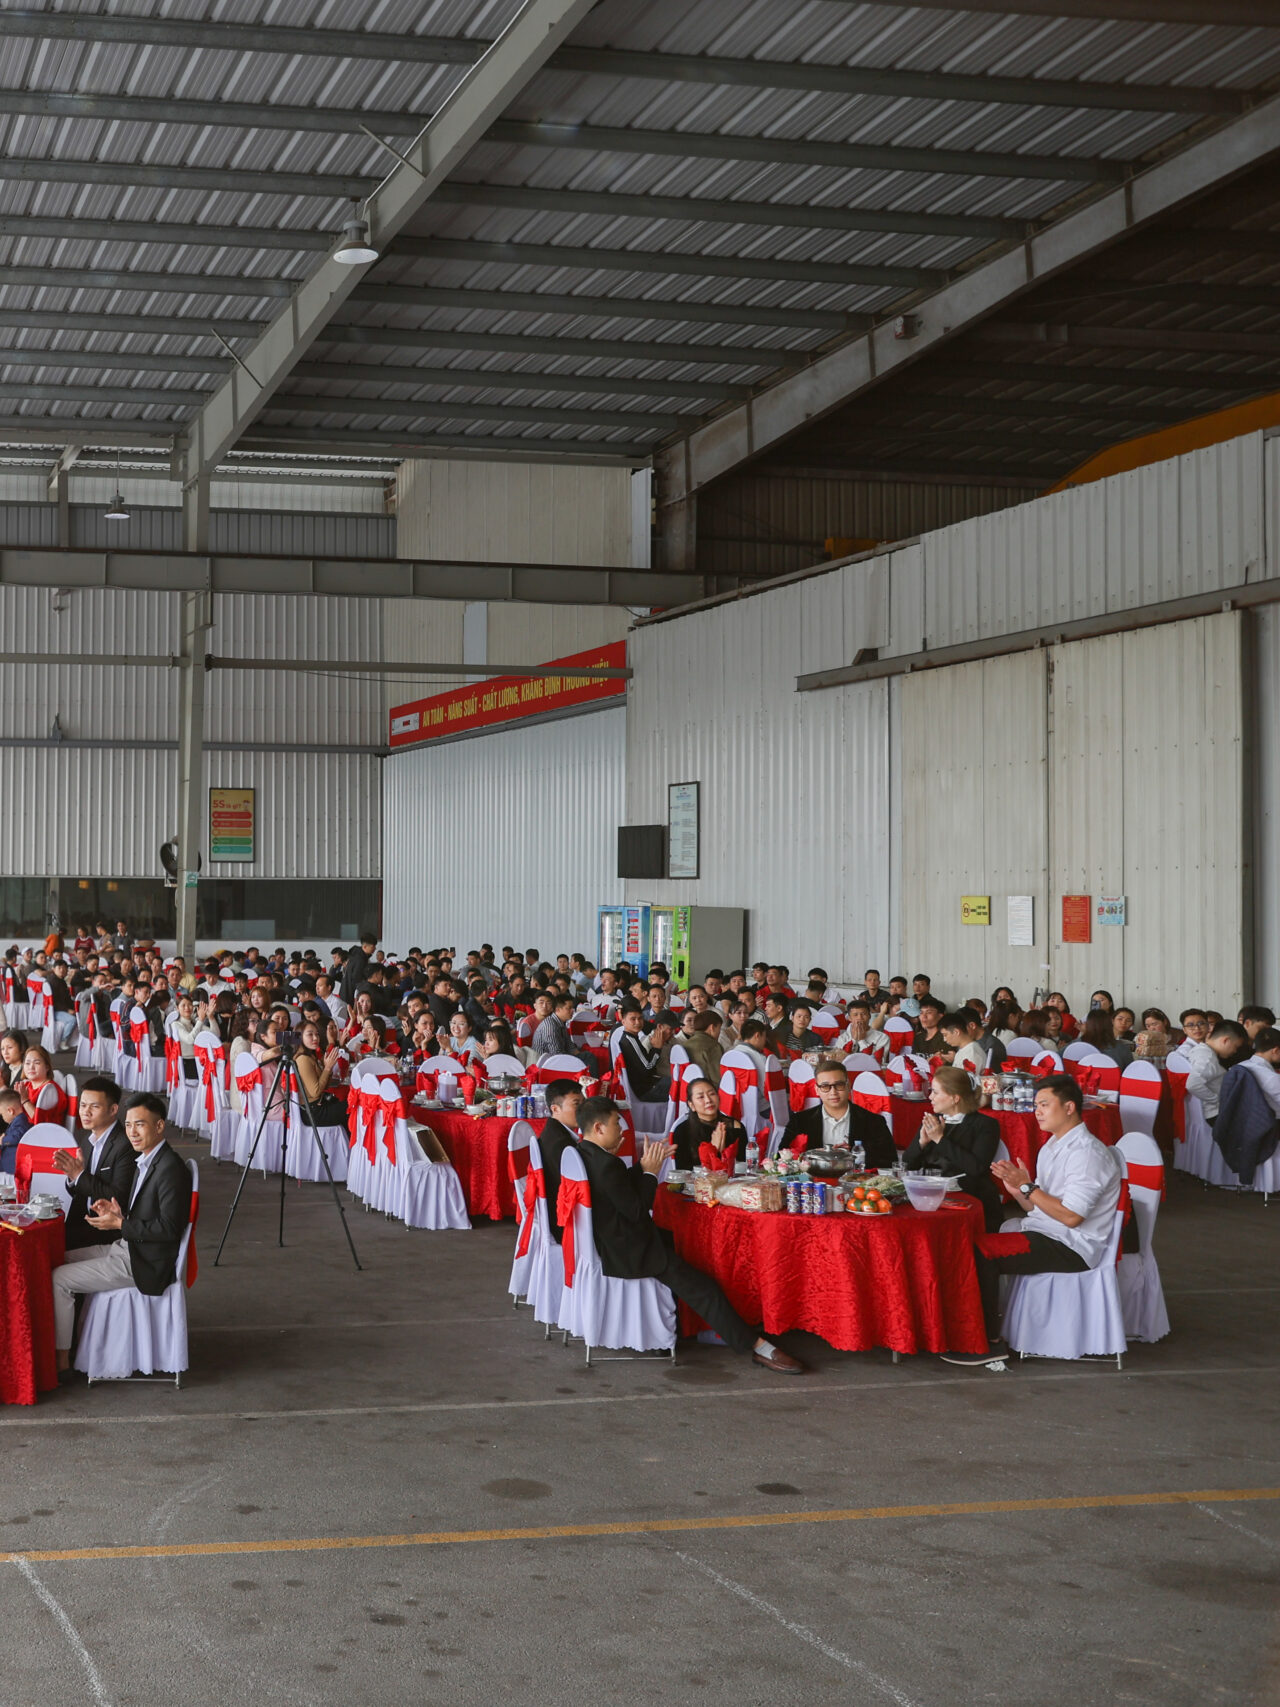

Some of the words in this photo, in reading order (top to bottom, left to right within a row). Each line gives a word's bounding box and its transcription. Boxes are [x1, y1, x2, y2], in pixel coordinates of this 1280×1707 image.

[423, 710, 430, 727] AN
[482, 685, 498, 712] CHẤT
[213, 800, 225, 808] 5S
